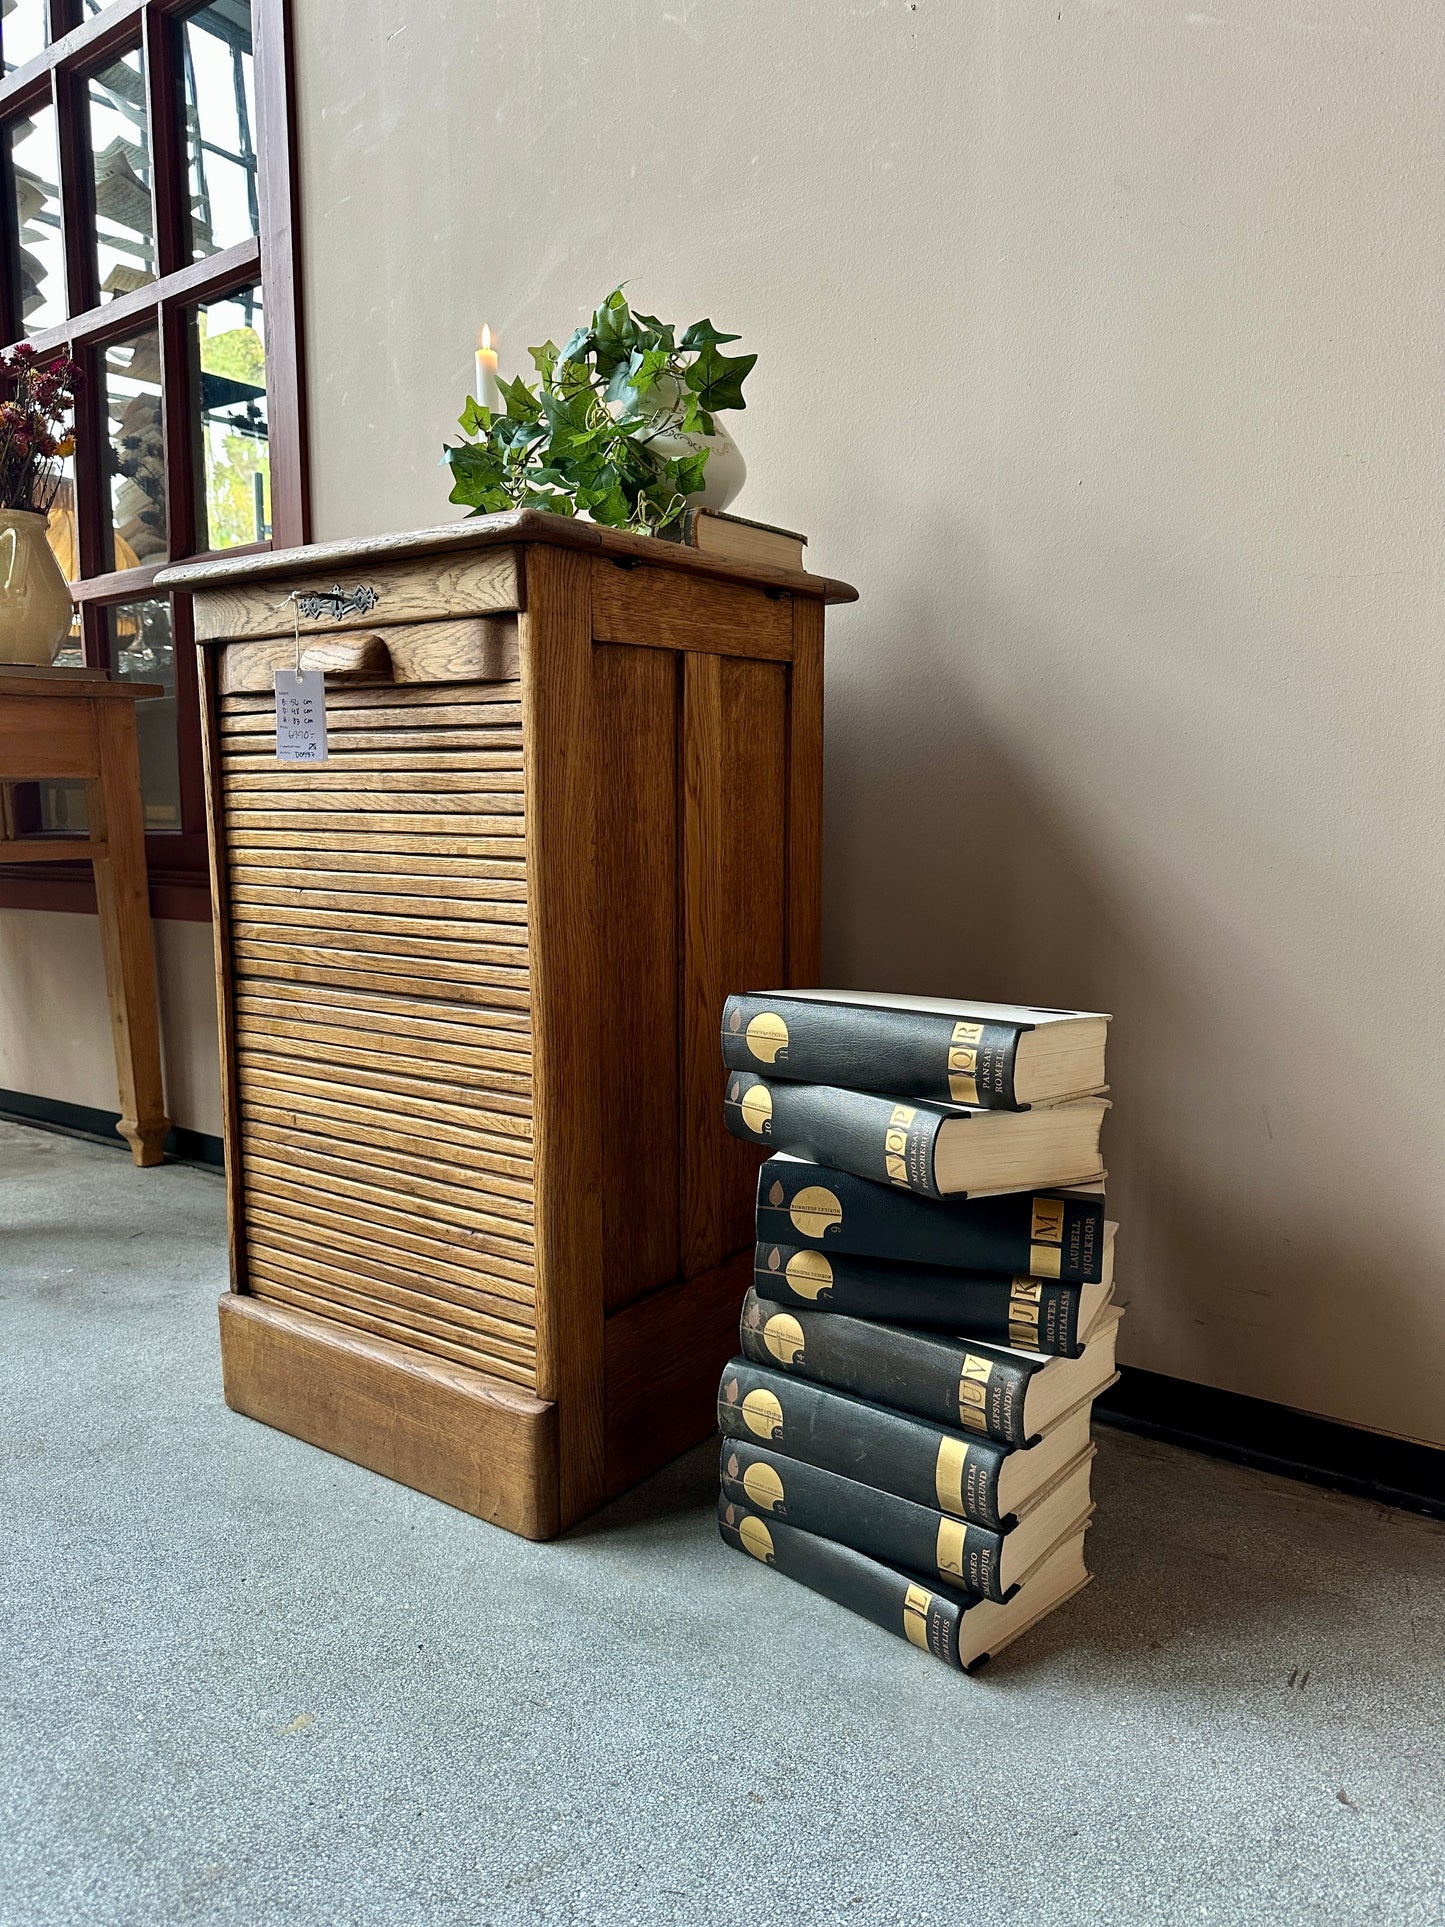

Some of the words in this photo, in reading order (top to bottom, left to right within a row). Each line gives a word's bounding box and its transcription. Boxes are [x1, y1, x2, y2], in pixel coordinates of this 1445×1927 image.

[956, 1026, 980, 1041] R
[780, 1050, 788, 1060] 11
[951, 1050, 974, 1070] Q
[982, 1046, 994, 1090] PANSAR
[994, 1046, 1006, 1094] ROMELL
[894, 1110, 909, 1124] P
[764, 1121, 773, 1137] 10
[888, 1134, 904, 1152] O
[888, 1159, 906, 1178] N
[1034, 1213, 1059, 1239] M
[1070, 1220, 1081, 1269] LAURELL
[1083, 1217, 1096, 1275] MJÖLKRÖR
[1014, 1279, 1038, 1299] K
[1012, 1307, 1035, 1321] J
[1047, 1299, 1057, 1342] HOLTER
[1059, 1290, 1070, 1353] KAPITALISM
[1012, 1330, 1035, 1342] I
[796, 1353, 806, 1367] 14
[965, 1358, 986, 1375] V
[963, 1383, 983, 1403] U
[962, 1410, 983, 1425] T
[774, 1427, 784, 1440] 13
[967, 1463, 978, 1514] SMALFILM
[940, 1557, 960, 1573] S
[970, 1552, 979, 1586] ROMEO
[908, 1595, 928, 1611] L
